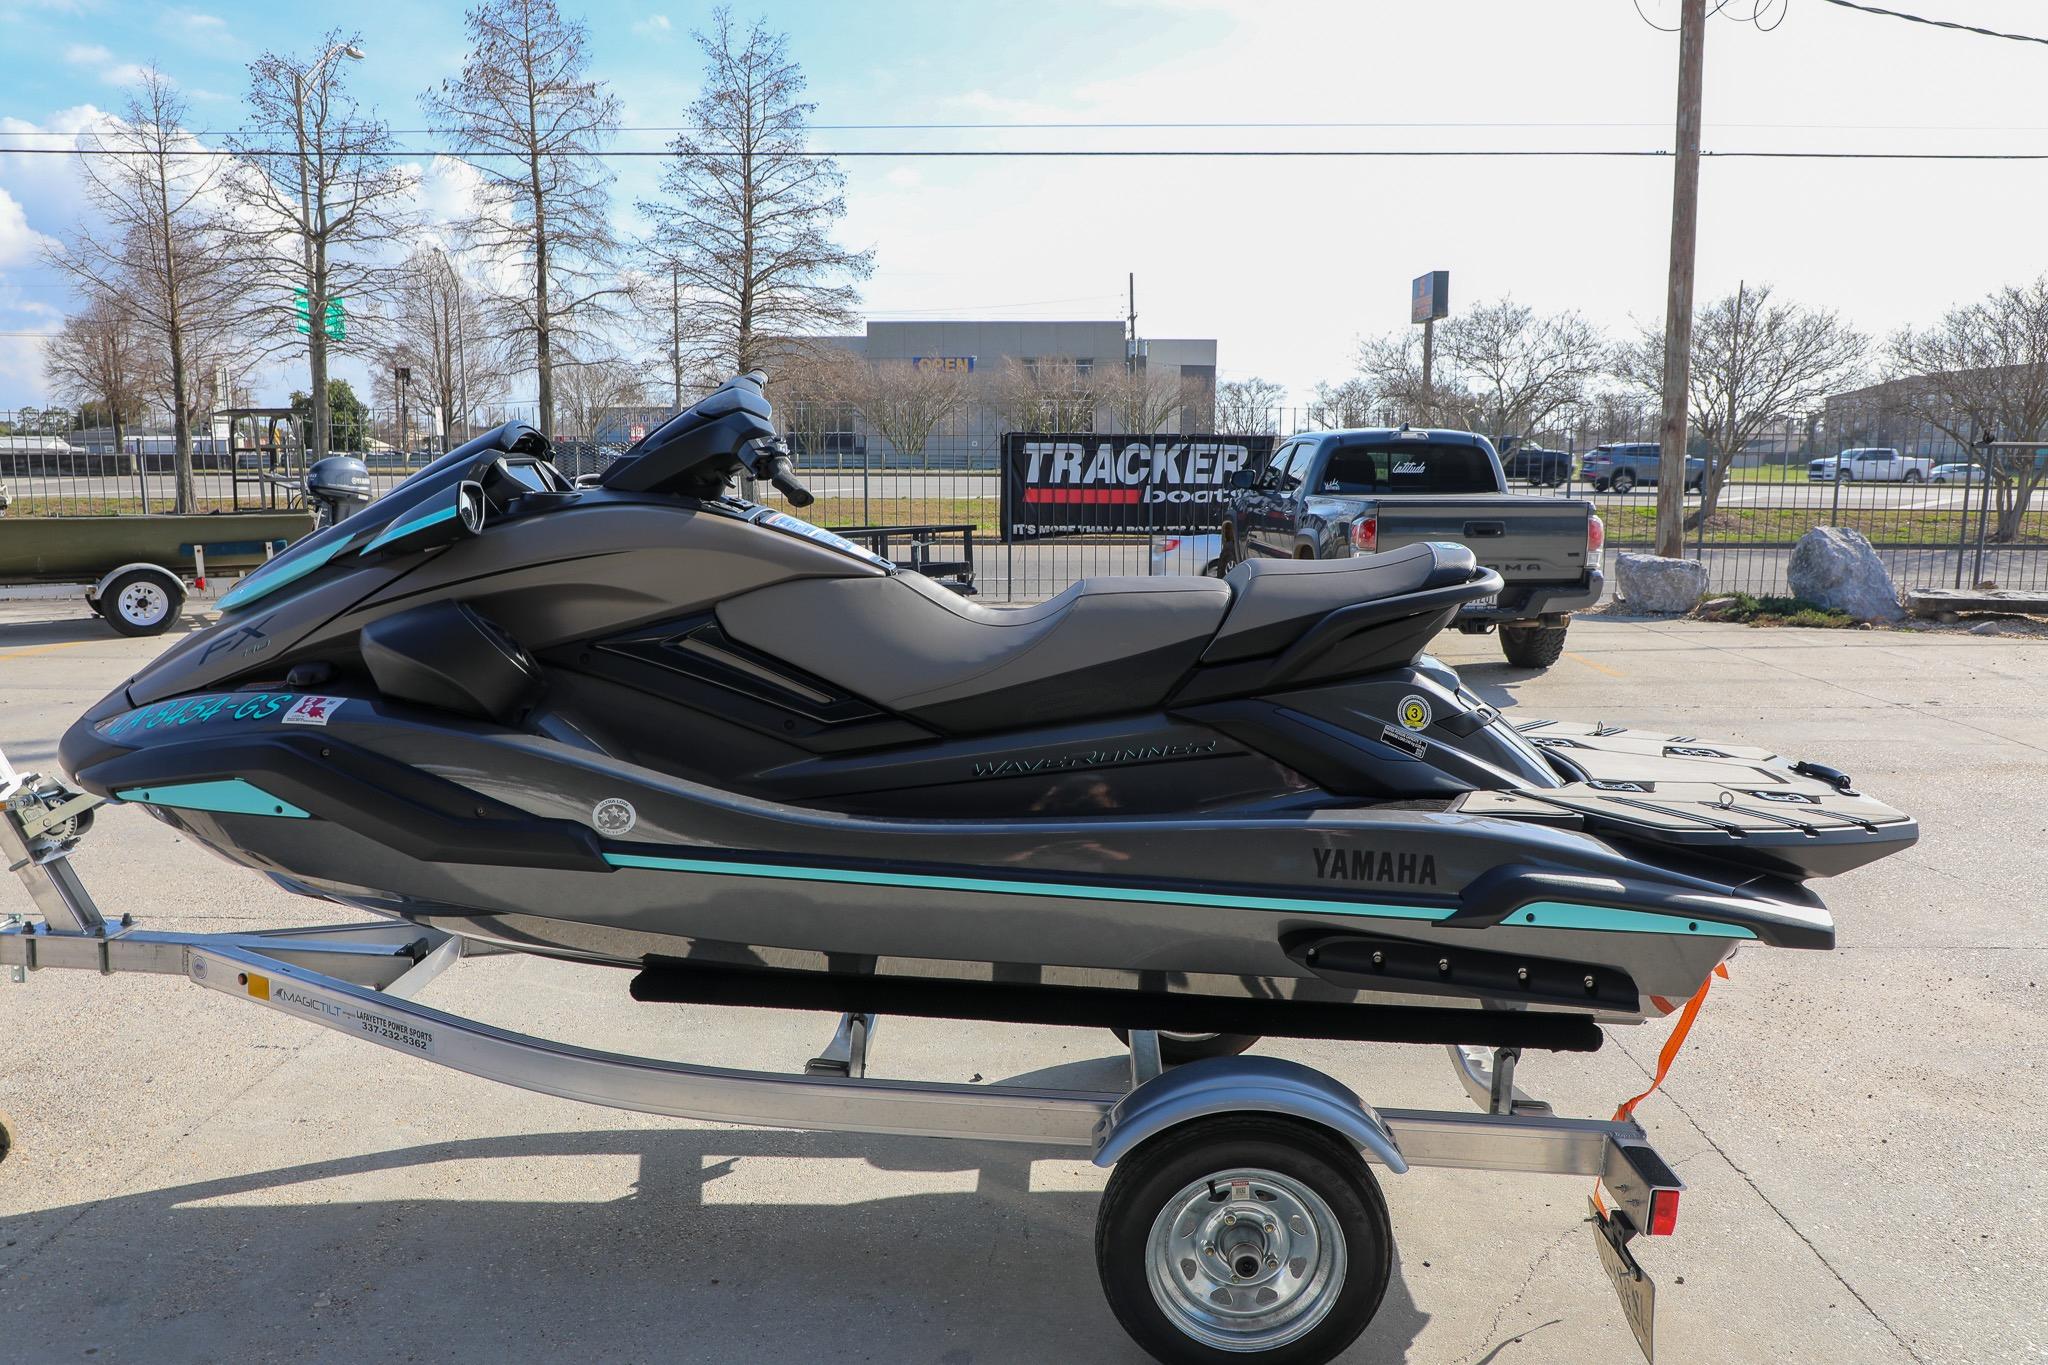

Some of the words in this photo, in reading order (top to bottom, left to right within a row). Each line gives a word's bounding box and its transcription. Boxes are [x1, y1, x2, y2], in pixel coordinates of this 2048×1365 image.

[918, 358, 968, 373] OPEN
[1023, 442, 1249, 485] TRACKER
[1012, 523, 1036, 535] IT'S
[198, 614, 277, 667] FX
[1410, 708, 1419, 719] 3
[616, 799, 630, 808] LOW
[1312, 847, 1438, 886] YAMAHA
[356, 1010, 387, 1029] LAFAYETTE
[387, 1020, 409, 1035] POWER
[409, 1028, 433, 1043] SPORTS
[362, 1021, 427, 1050] 337-232-5362
